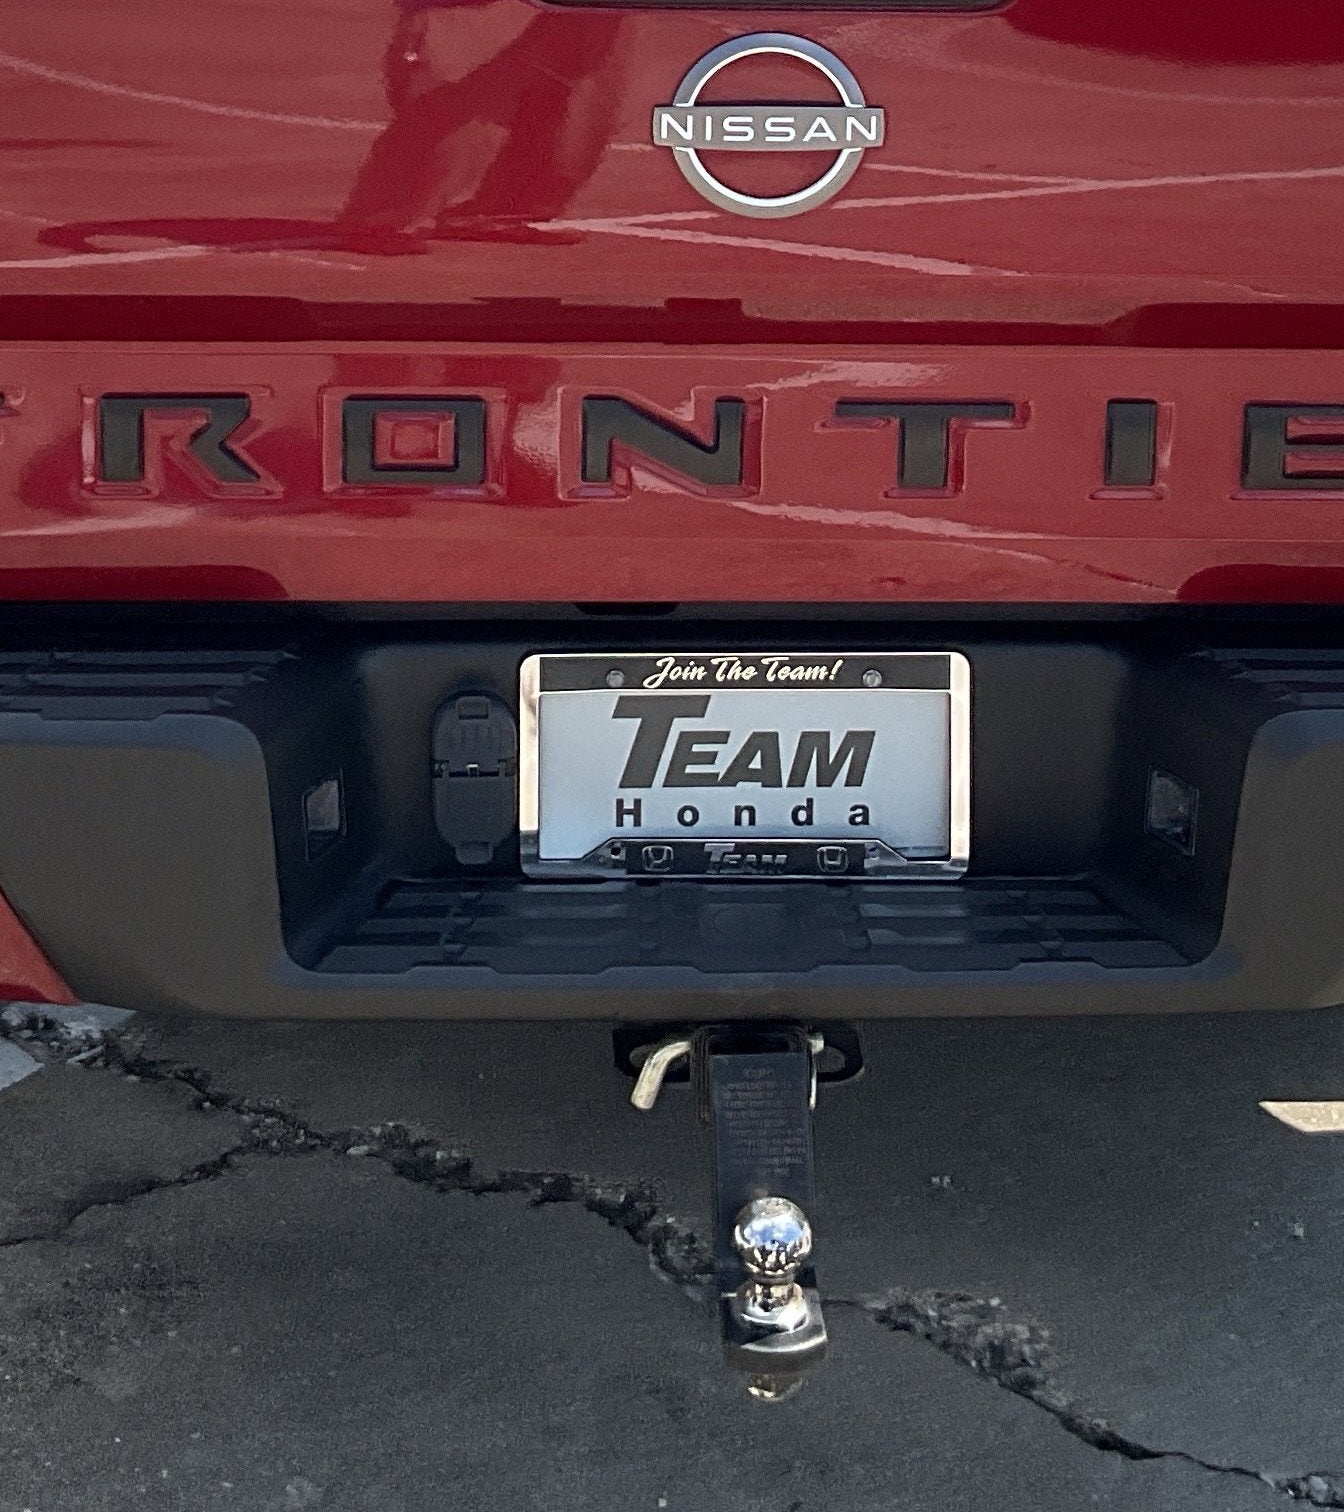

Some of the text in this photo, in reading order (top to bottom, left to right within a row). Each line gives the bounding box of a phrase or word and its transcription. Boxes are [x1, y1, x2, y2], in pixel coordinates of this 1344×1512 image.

[660, 113, 877, 142] NISSAN
[642, 655, 844, 688] Join The Team!
[611, 695, 876, 788] TEAM
[615, 797, 870, 827] Honda
[704, 842, 788, 875] TEAM
